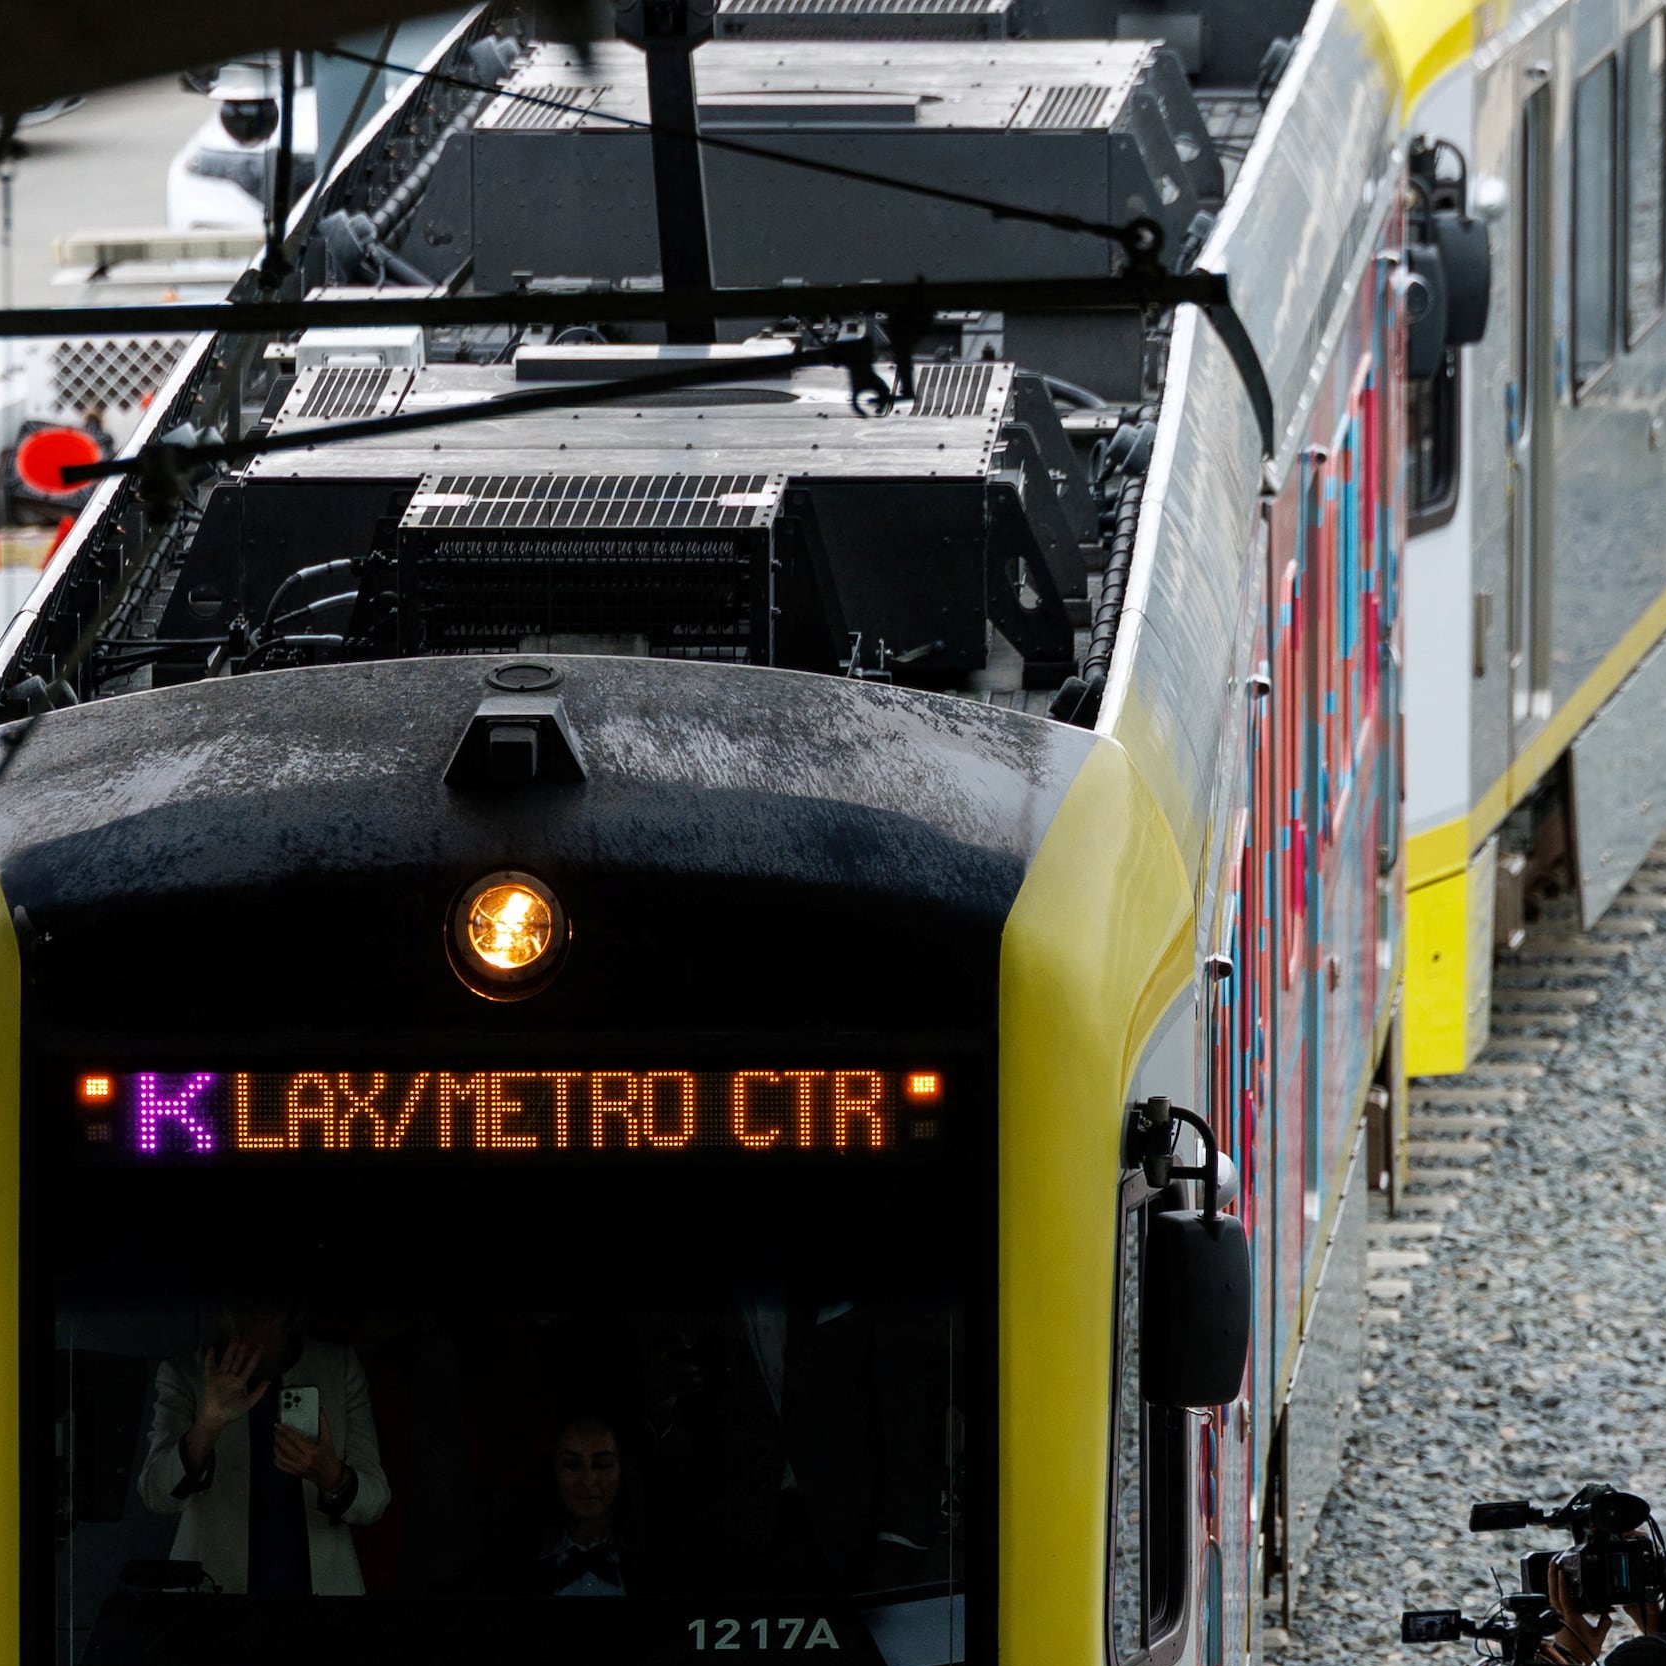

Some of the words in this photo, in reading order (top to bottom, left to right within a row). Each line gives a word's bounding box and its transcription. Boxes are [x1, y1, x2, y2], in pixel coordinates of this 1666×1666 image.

[136, 1072, 213, 1152] K
[237, 1070, 697, 1150] LAX/METRO
[732, 1069, 884, 1149] CTR
[688, 1618, 839, 1650] 1217A
